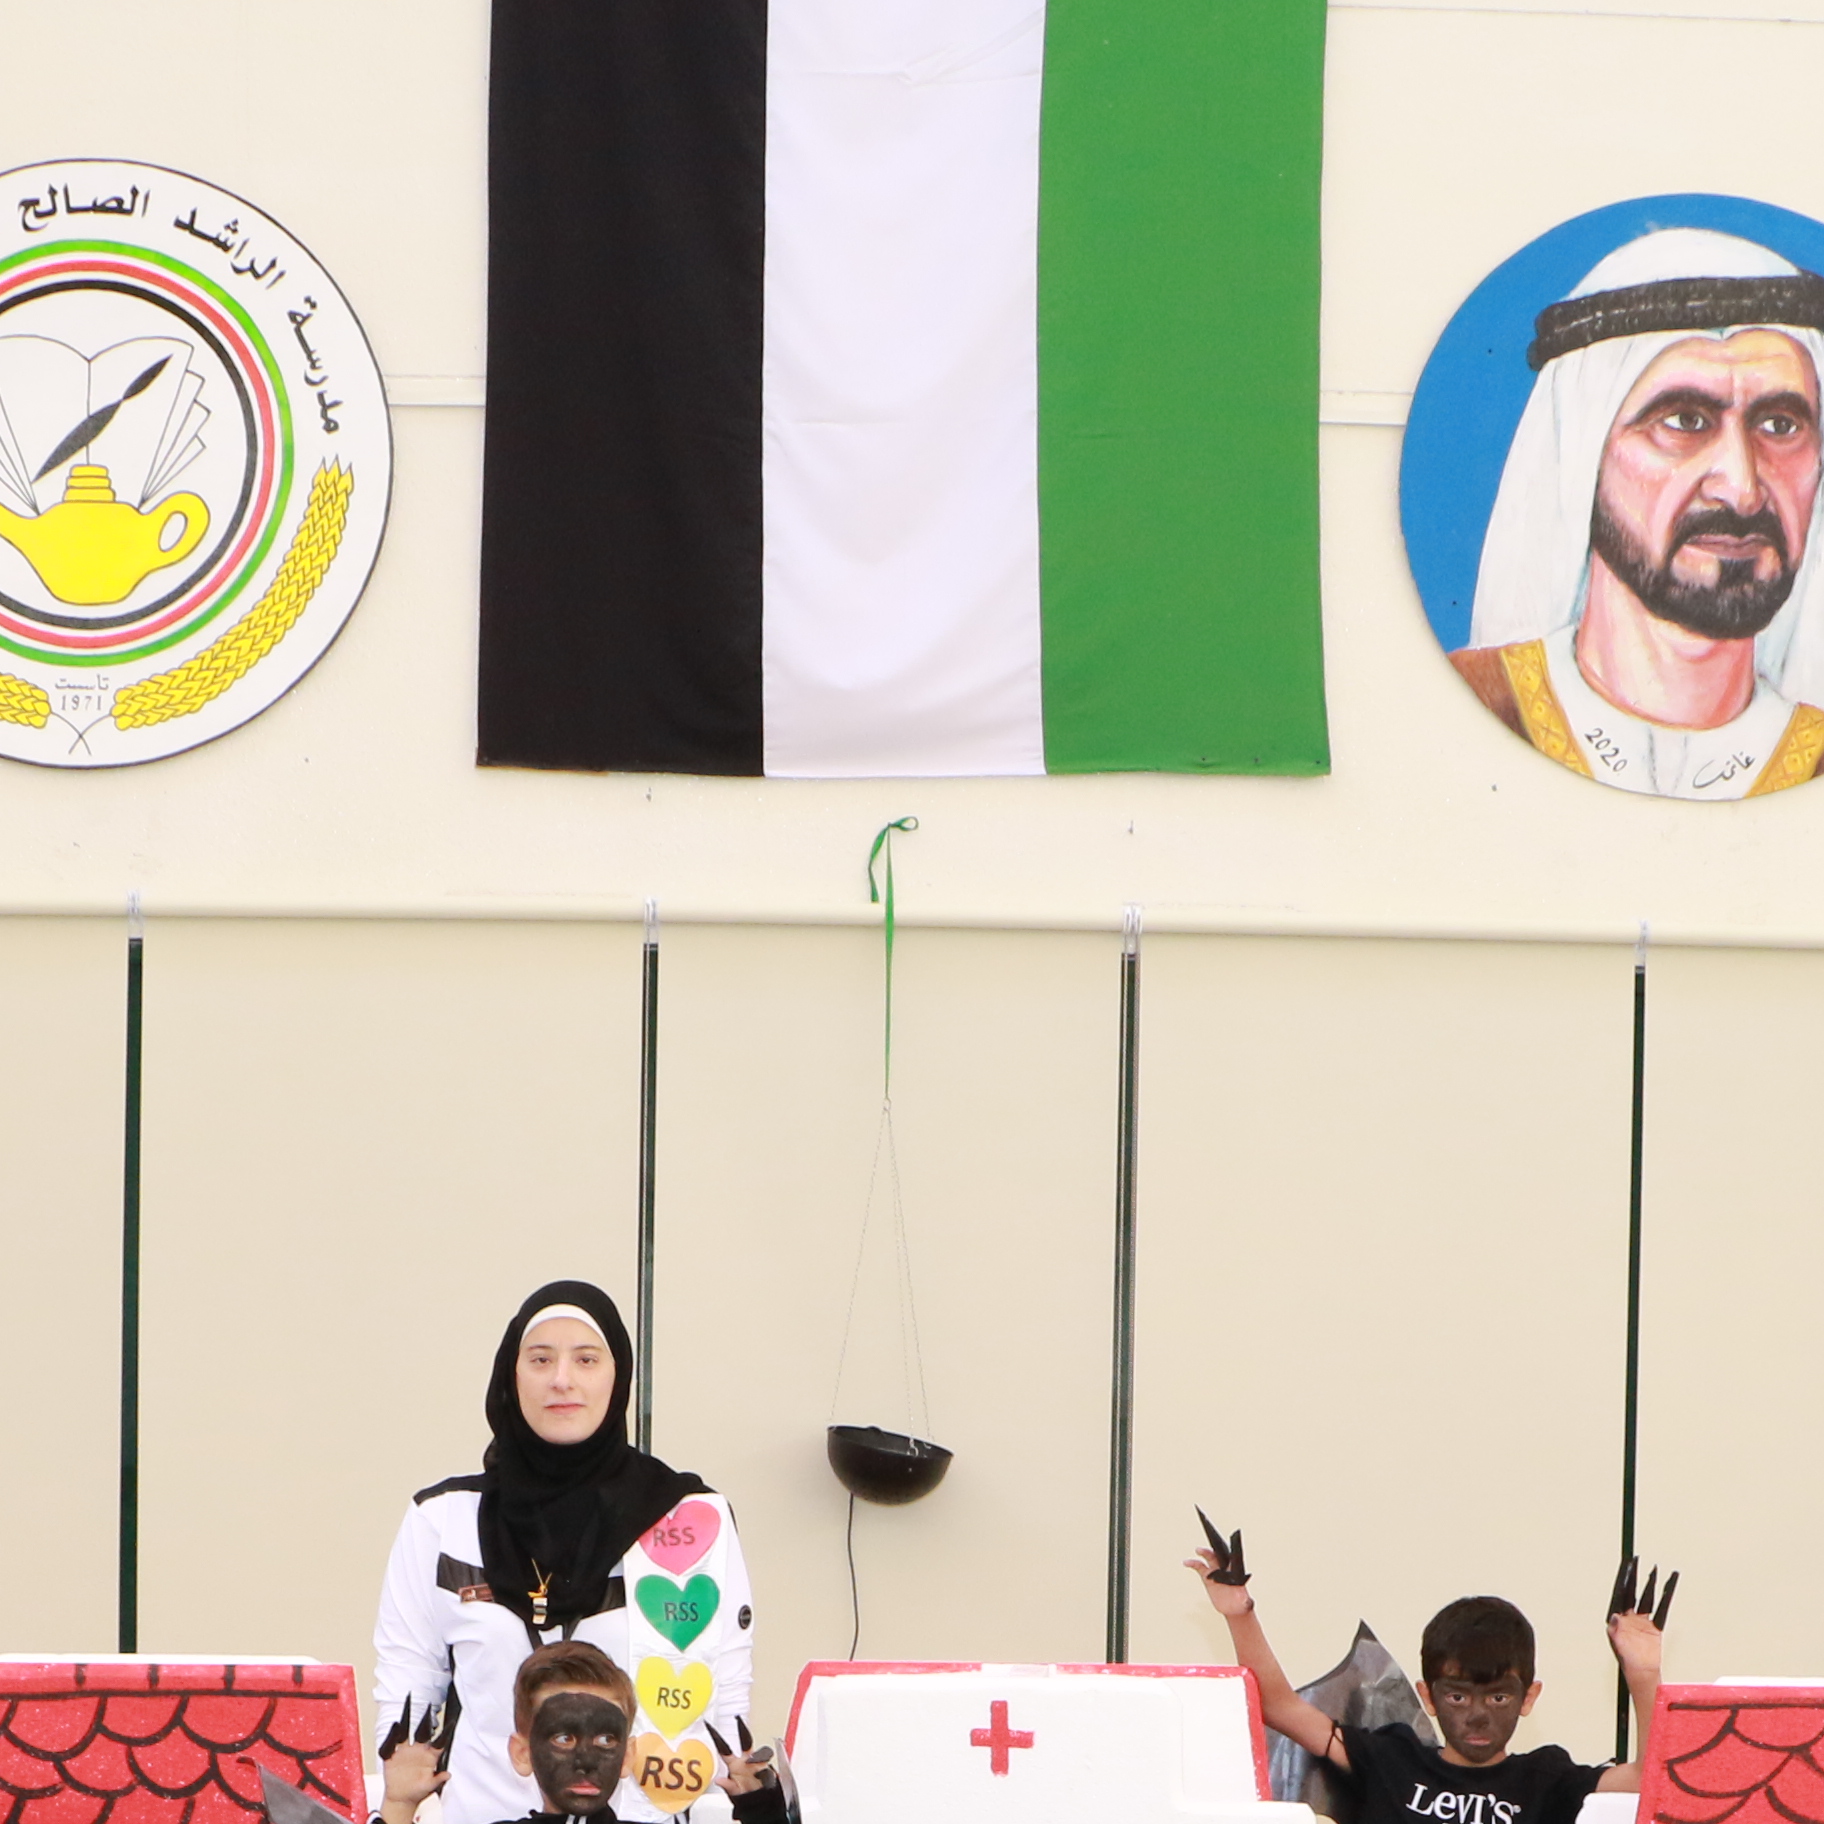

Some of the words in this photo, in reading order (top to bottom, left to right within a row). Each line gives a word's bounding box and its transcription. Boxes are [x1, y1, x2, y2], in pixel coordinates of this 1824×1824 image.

[17, 185, 149, 230] الصالح
[173, 207, 286, 290] الراشد
[287, 295, 343, 434] مدرسة
[62, 695, 102, 711] 1971
[653, 1526, 696, 1547] RSS
[664, 1602, 699, 1622] RSS
[656, 1686, 692, 1710] RSS
[639, 1754, 705, 1793] RSS
